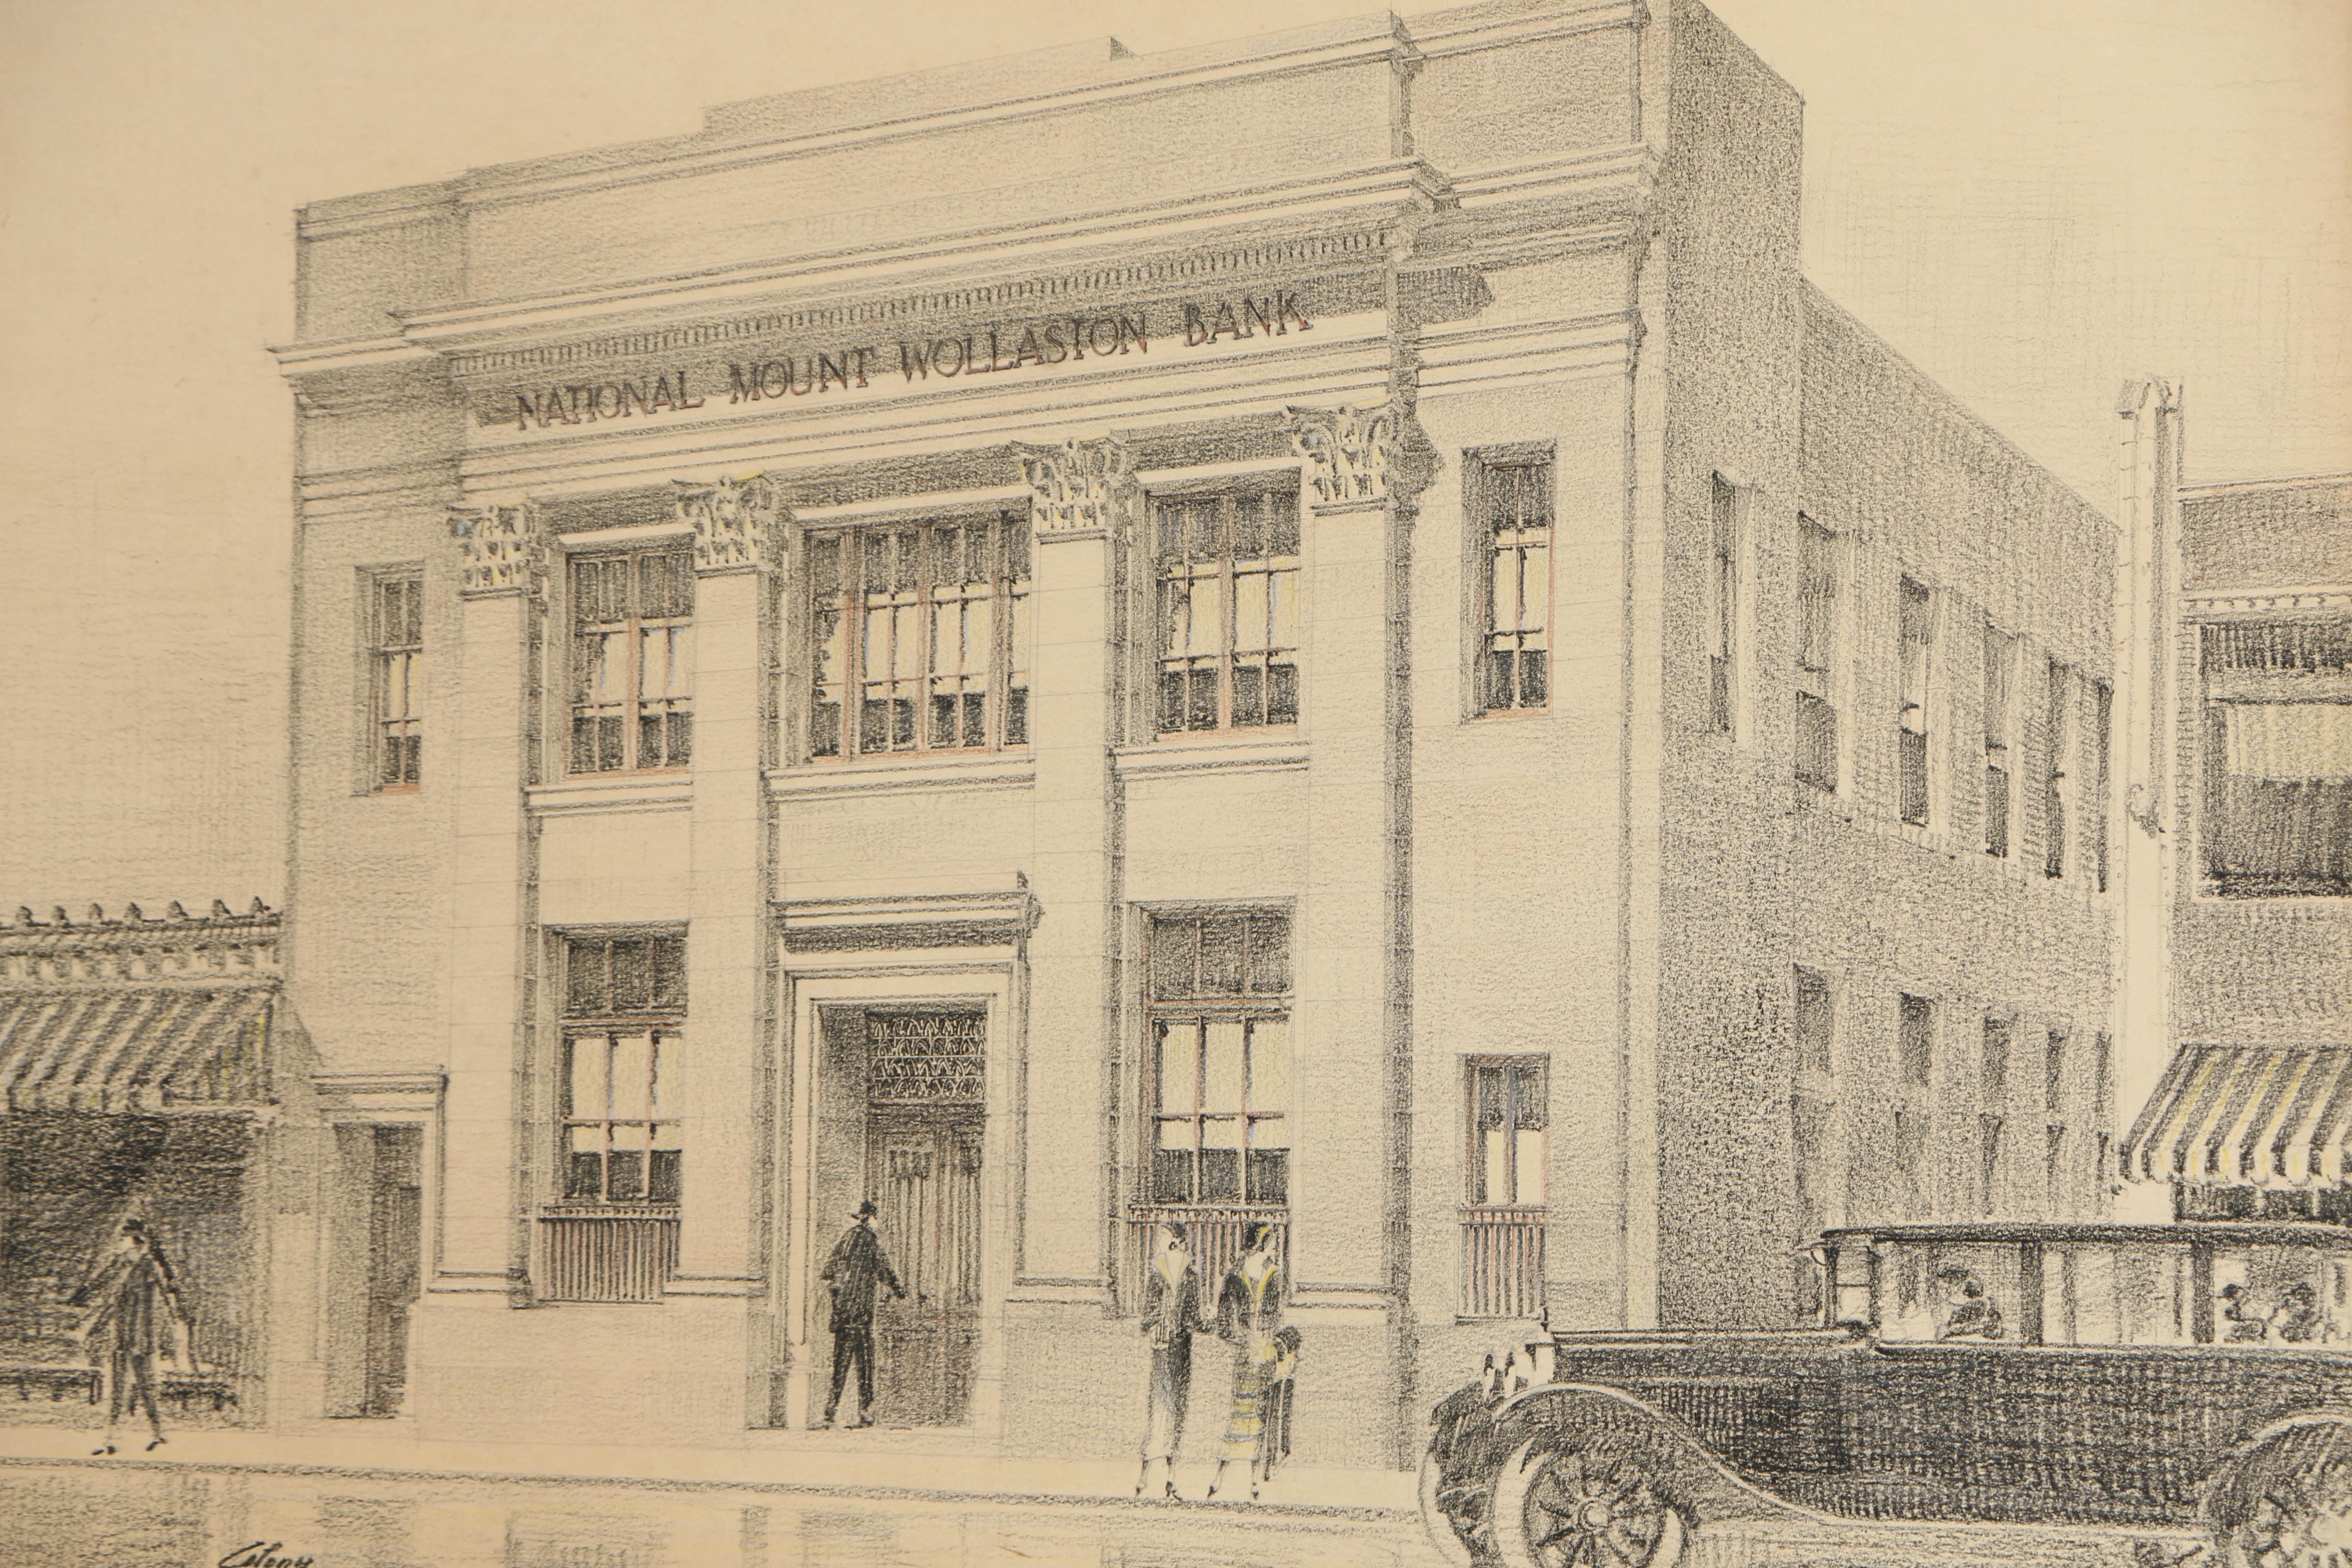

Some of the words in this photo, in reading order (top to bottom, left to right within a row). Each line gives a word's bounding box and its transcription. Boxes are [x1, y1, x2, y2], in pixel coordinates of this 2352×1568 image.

[517, 370, 706, 430] NATIONAL
[729, 346, 876, 404] MOUNT
[900, 313, 1148, 382] WOLLASTON
[1183, 290, 1314, 346] BANK
